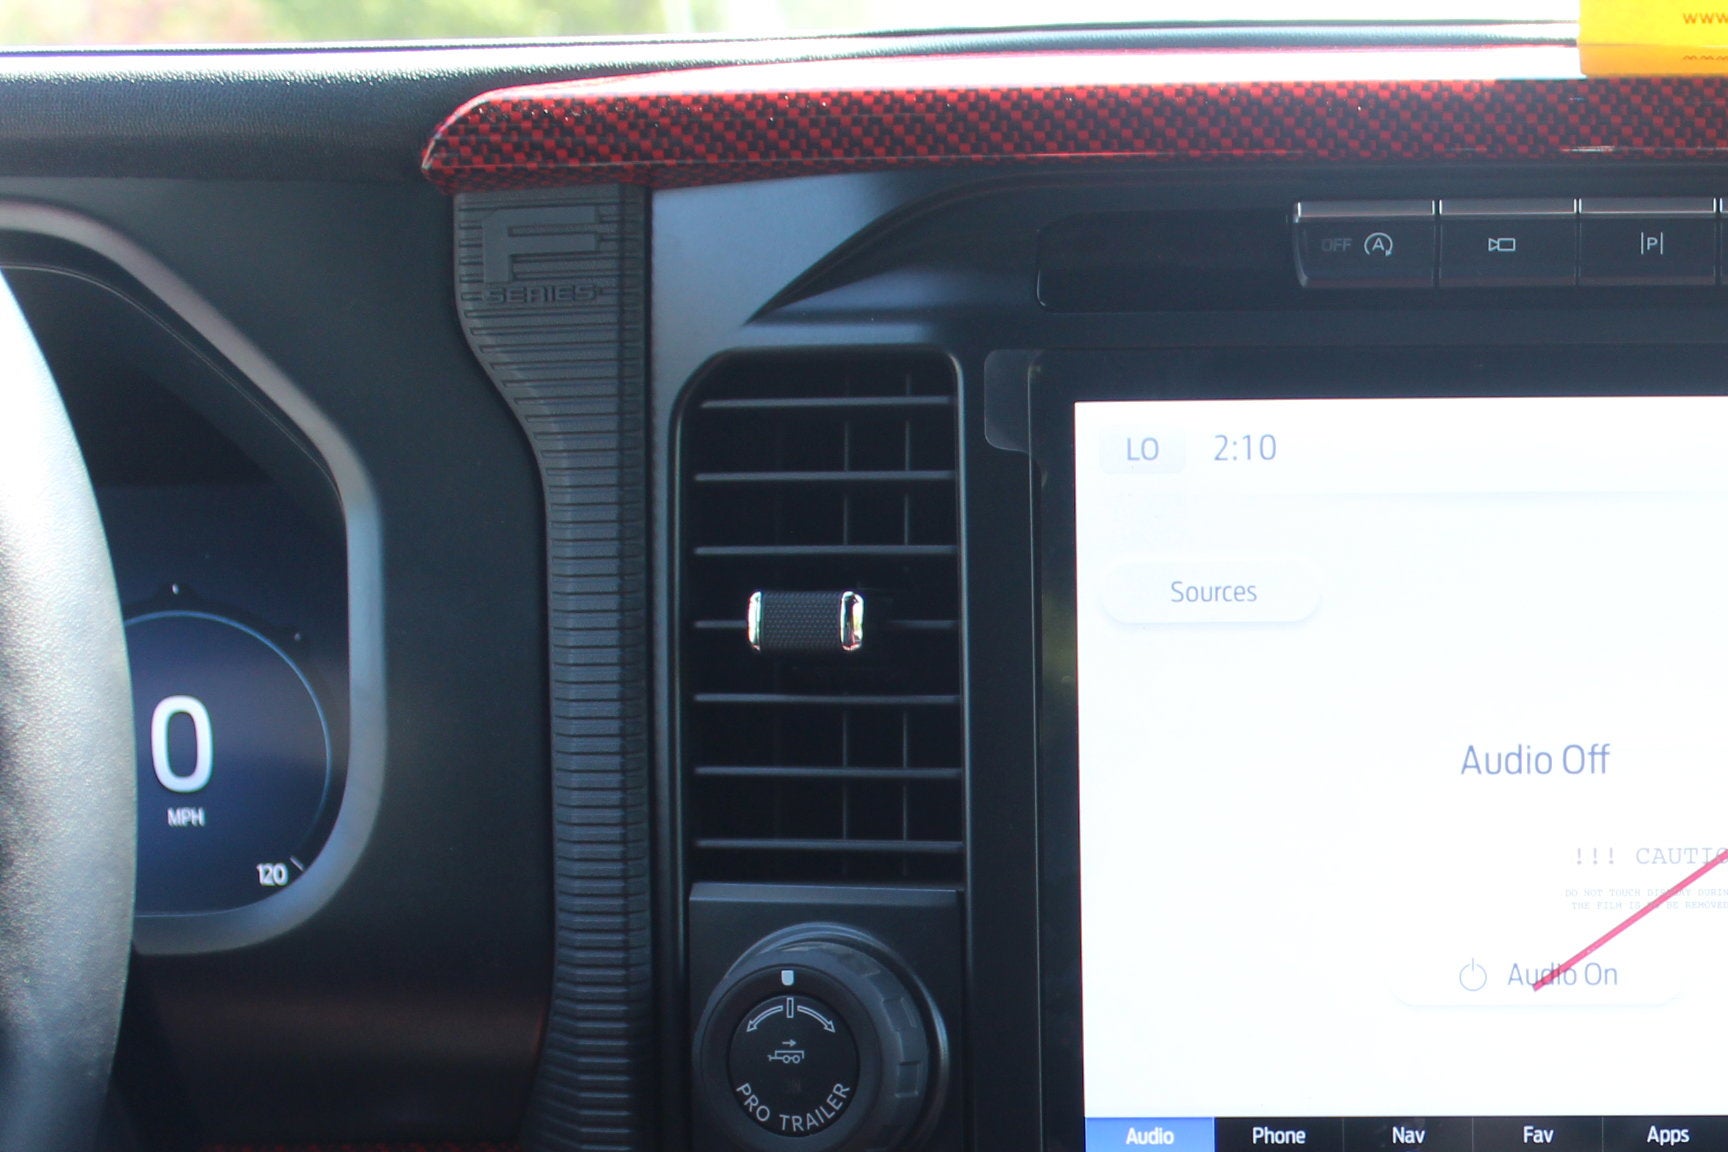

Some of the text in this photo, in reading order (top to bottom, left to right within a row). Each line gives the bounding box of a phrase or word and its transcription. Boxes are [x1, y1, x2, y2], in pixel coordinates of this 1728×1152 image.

[1321, 238, 1352, 251] OFF
[485, 284, 599, 304] SERIES
[1125, 436, 1160, 462] LO
[1213, 434, 1277, 462] 2:10
[1170, 580, 1258, 603] Sources
[151, 694, 213, 793] 0
[1461, 743, 1611, 775] Audio Off
[167, 807, 205, 827] MPH
[256, 862, 288, 886] 120
[1647, 888, 1691, 897] DISAY
[1507, 962, 1618, 987] Audio On
[736, 1082, 850, 1132] PRO TRAILER
[1126, 1127, 1175, 1145] Audio
[1252, 1126, 1306, 1144] Phone
[1393, 1127, 1425, 1144] Nav
[1523, 1127, 1554, 1144] Fav
[1647, 1126, 1690, 1148] Apps
